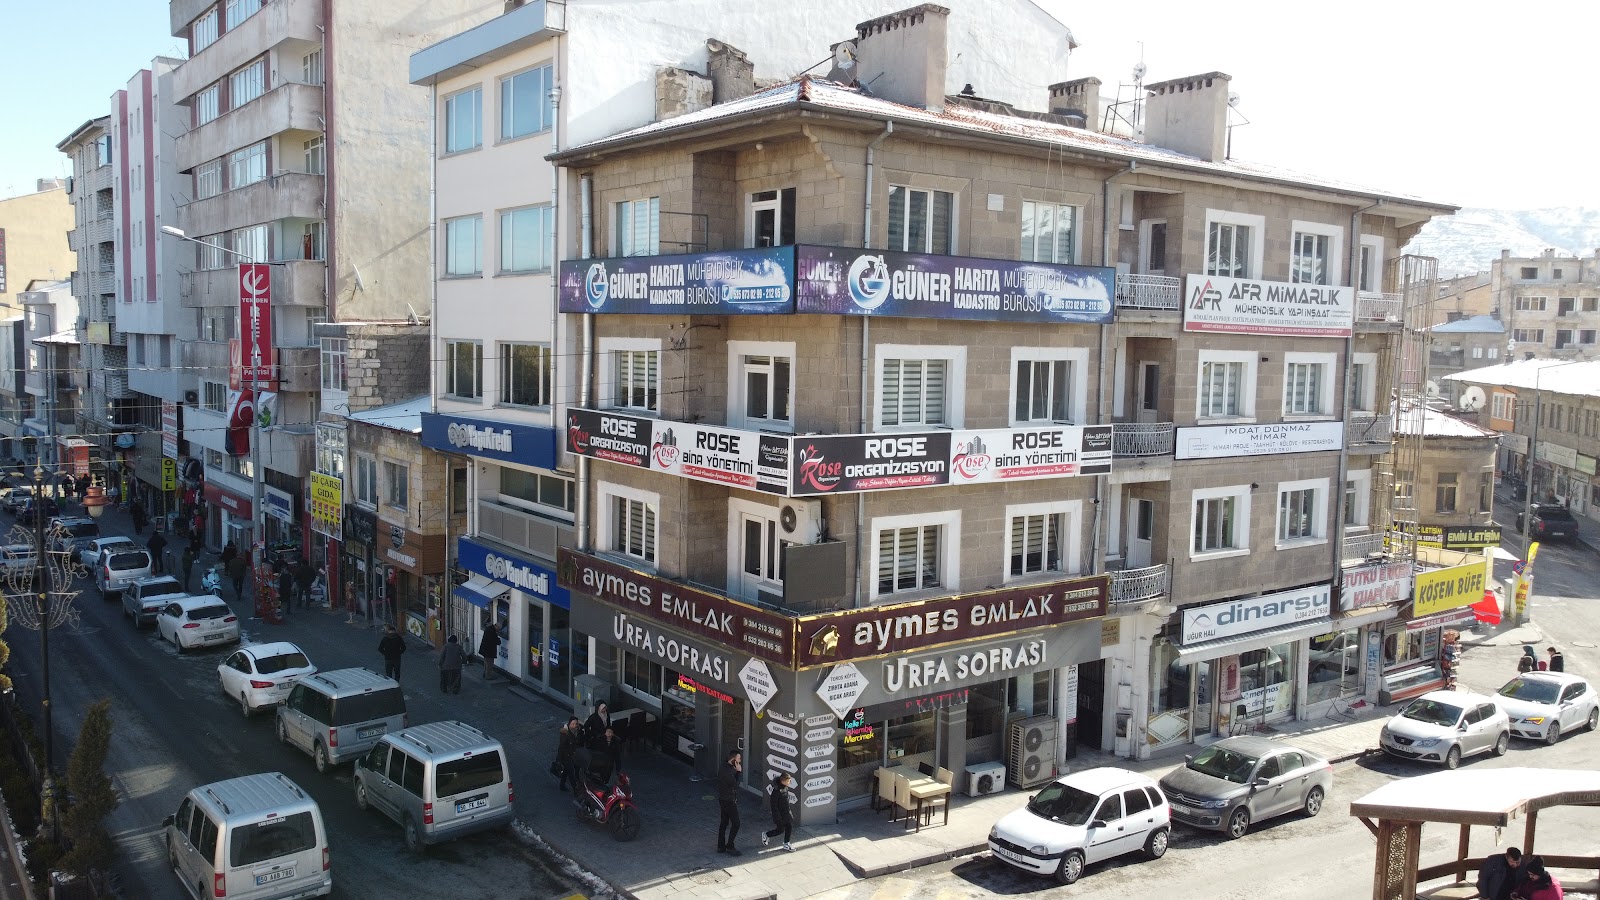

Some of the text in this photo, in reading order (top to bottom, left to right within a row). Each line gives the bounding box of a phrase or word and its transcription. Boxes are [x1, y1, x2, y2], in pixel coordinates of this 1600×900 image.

[650, 264, 684, 287] HARİTA
[687, 258, 744, 280] MÜHENDİSLİK
[954, 267, 1000, 292] HARİTA
[1004, 268, 1067, 291] MÜHENDİSLİK
[609, 268, 648, 299] GÜNER
[893, 264, 951, 302] GÜNER
[1228, 282, 1340, 306] AFR MİMARLIK
[650, 289, 684, 305] KADASTRO
[687, 284, 720, 305] BÜROSU
[953, 293, 1000, 311] KADASTRO
[1003, 291, 1041, 312] BÜROSU
[1234, 303, 1285, 316] MÜHENDİSLİK
[601, 416, 637, 439] ROSE
[1225, 426, 1260, 435] İMDAT
[1251, 432, 1287, 441] MİMAR
[590, 435, 648, 457] ORGANİZASYON
[697, 430, 740, 455] ROSE
[865, 437, 927, 459] ROSE
[1012, 431, 1063, 450] ROSE
[683, 450, 703, 465] BİNA
[707, 453, 753, 475] YÖNETİMİ
[844, 460, 945, 478] ORGANİZASYON
[995, 454, 1020, 468] BİNA
[1025, 449, 1077, 466] YÖNETİMİ
[317, 487, 335, 501] GIDA
[1447, 530, 1500, 543] EMİN İLETİŞİM
[1345, 570, 1376, 588] TUTKU
[1419, 572, 1483, 606] KÖŞEM BÜFE
[583, 567, 734, 636] aymes EMLAK
[1217, 592, 1328, 626] dinarsu
[1187, 629, 1216, 641] UĞUR HALI
[657, 636, 729, 684] SOFRASI
[956, 640, 1047, 680] SOFRASI
